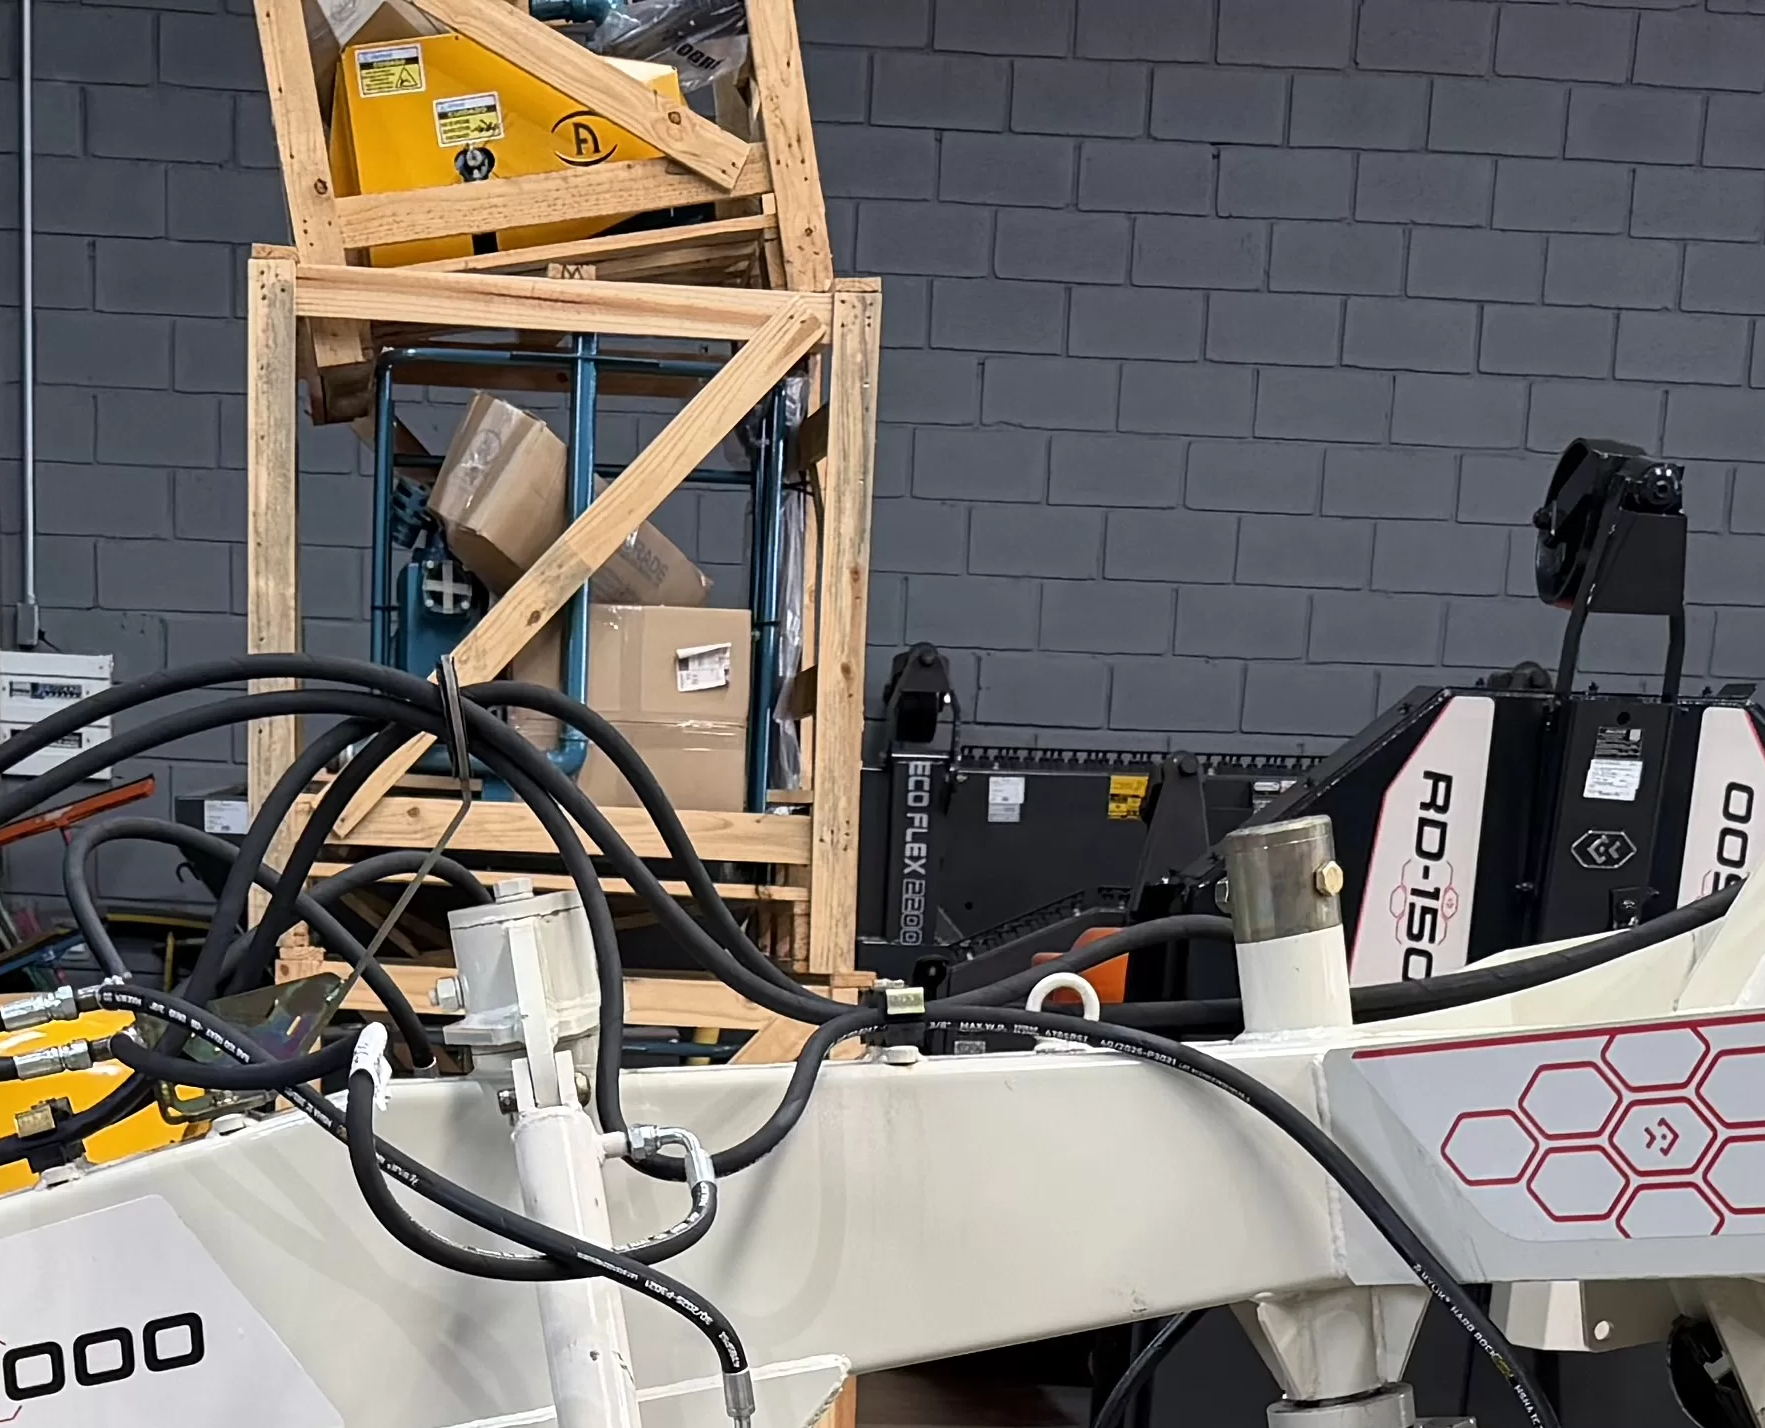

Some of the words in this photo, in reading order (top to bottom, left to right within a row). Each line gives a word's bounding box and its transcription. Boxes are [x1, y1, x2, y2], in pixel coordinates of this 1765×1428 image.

[906, 760, 932, 807] ECO
[902, 812, 930, 875] FLEX
[1401, 769, 1454, 982] RD-150
[899, 877, 926, 946] 2200
